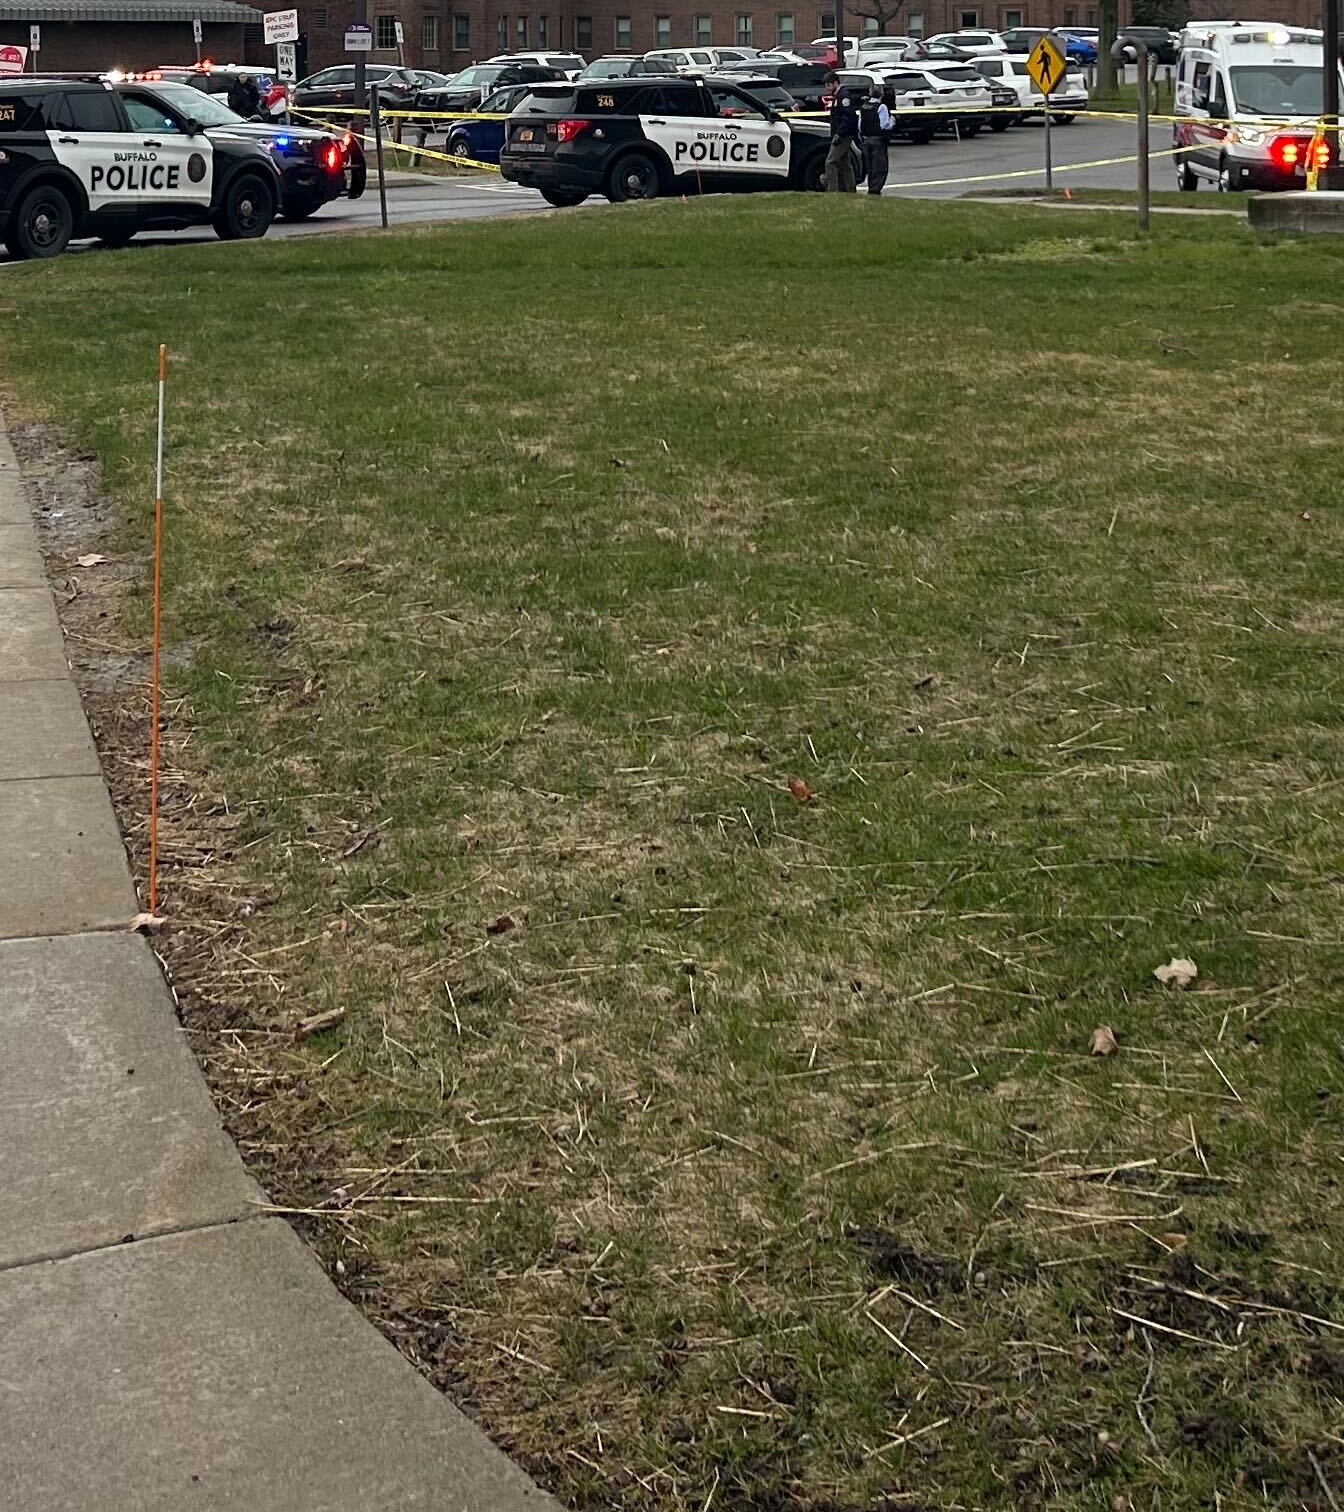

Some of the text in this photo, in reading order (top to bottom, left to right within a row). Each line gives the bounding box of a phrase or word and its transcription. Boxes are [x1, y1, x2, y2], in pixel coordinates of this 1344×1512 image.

[279, 45, 294, 56] ONE
[279, 57, 294, 67] WAY
[697, 132, 738, 141] BUFFALO
[675, 141, 759, 162] POLICE
[113, 152, 157, 162] BUFFALO
[91, 165, 180, 191] POLICE
